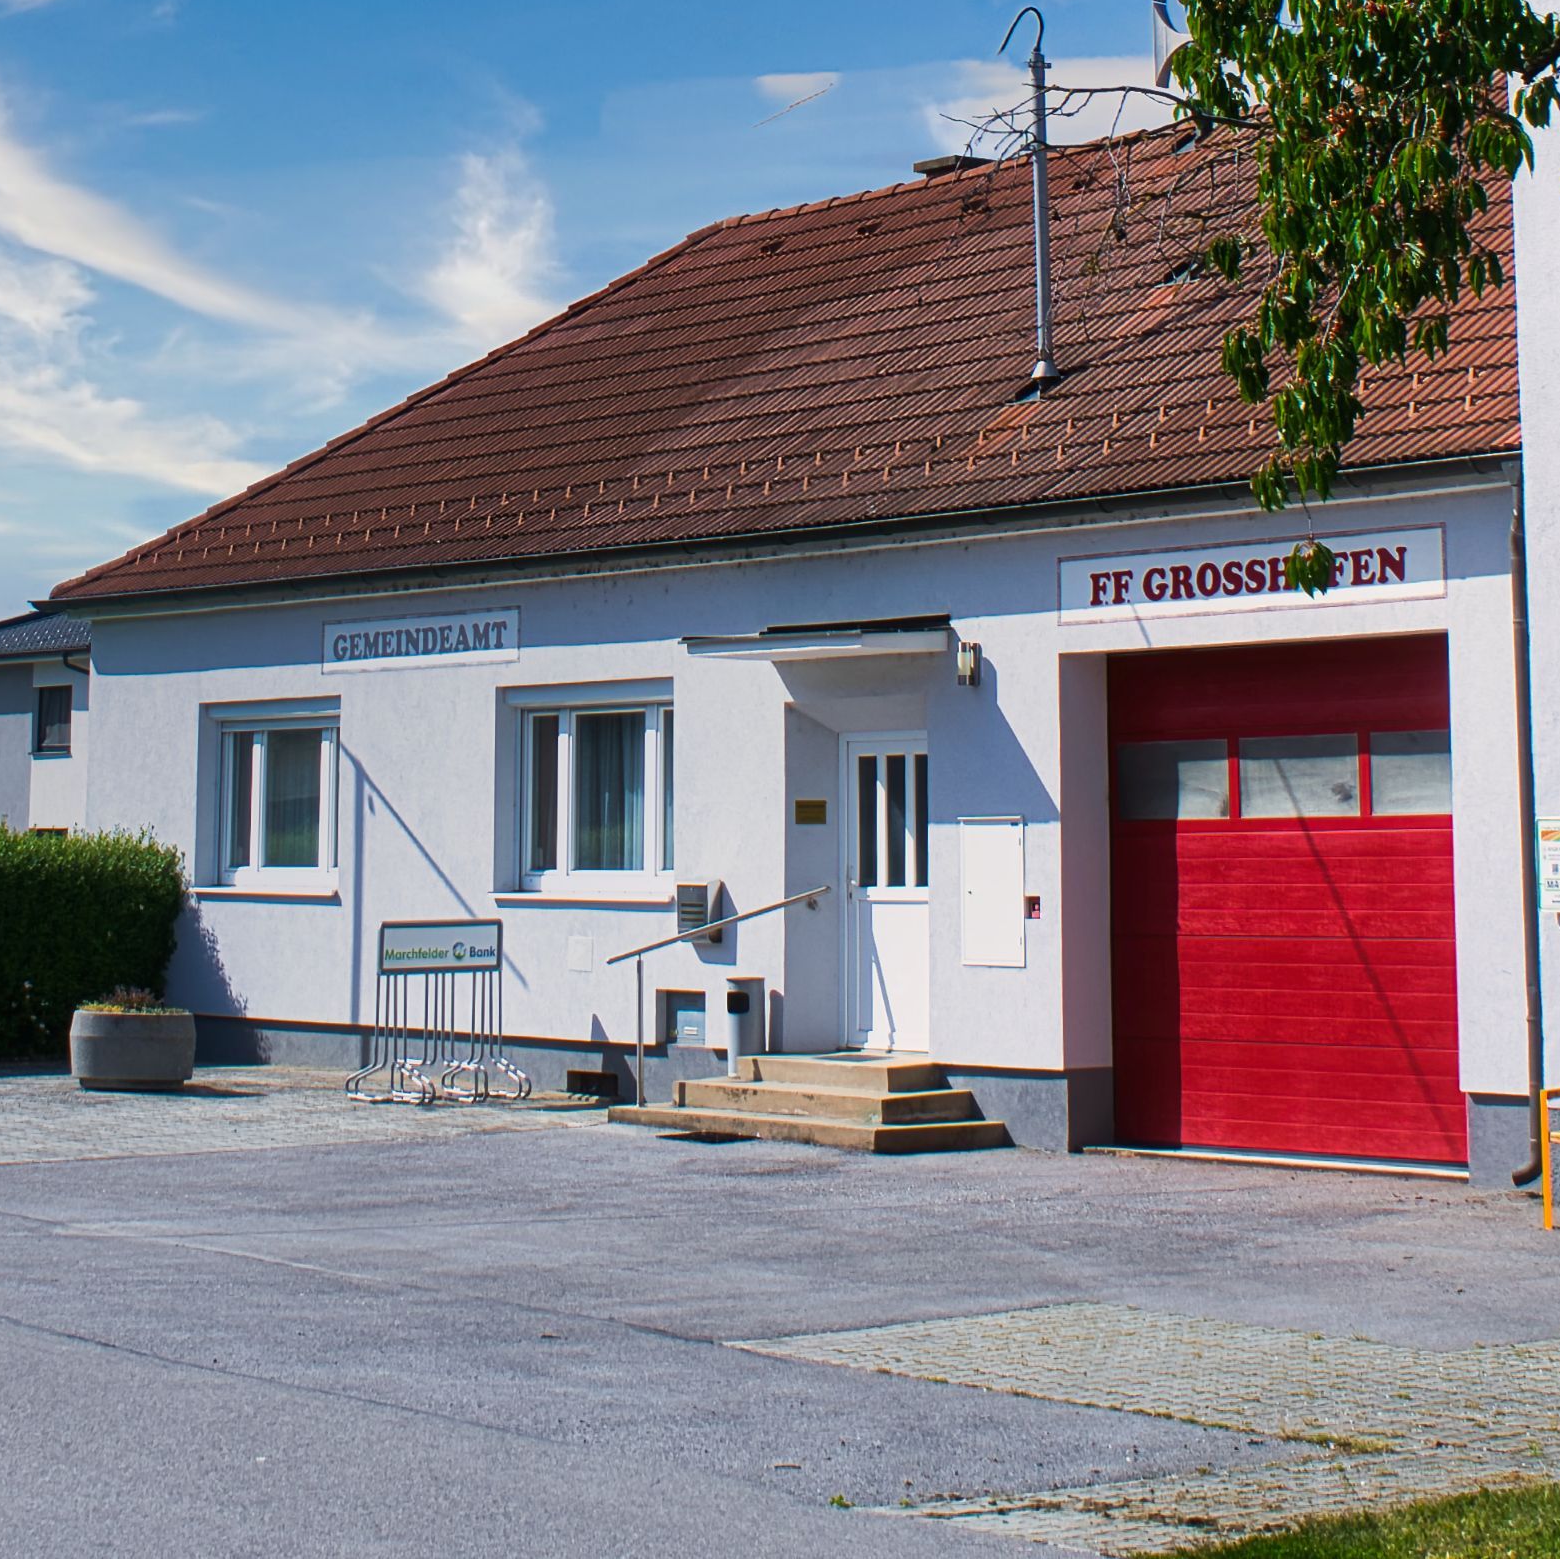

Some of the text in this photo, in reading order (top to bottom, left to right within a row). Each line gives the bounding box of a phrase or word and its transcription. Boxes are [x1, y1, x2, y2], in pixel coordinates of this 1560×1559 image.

[1142, 546, 1407, 601] GROSSHFEN
[333, 621, 507, 660] GEMEINDEAMT
[384, 945, 496, 960] Marchfelder Bank
